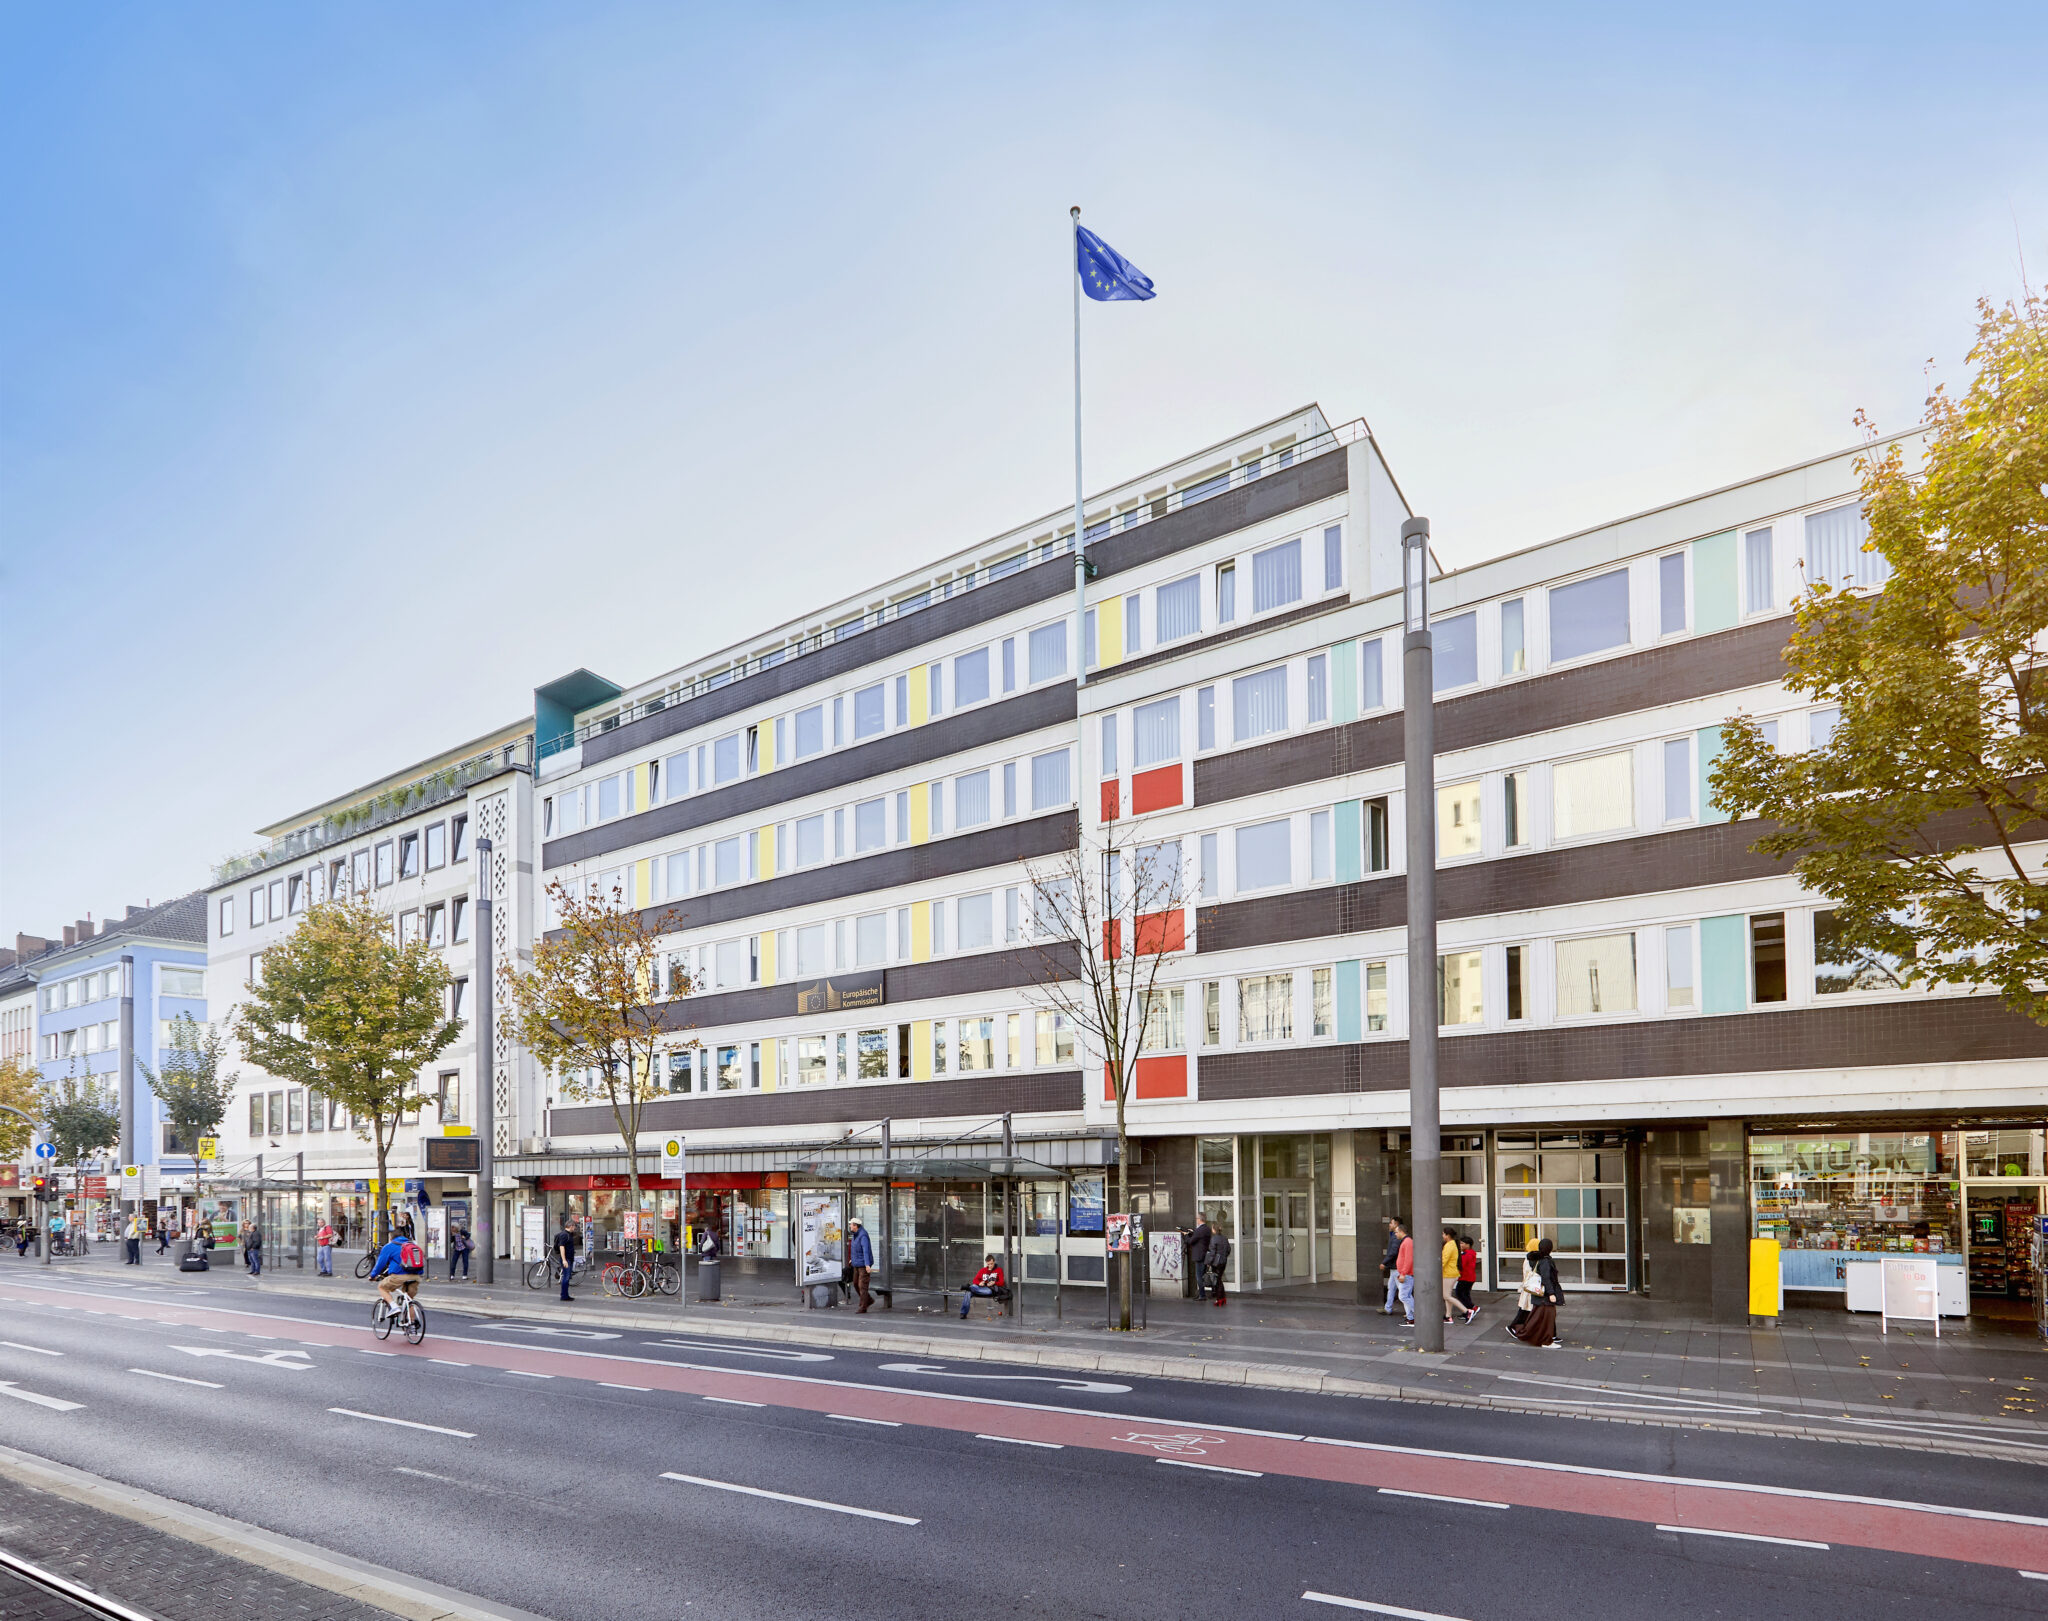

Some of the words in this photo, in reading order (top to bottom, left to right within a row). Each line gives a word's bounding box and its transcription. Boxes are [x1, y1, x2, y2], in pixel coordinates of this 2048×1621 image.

[842, 988, 878, 999] Europäische
[842, 997, 878, 1008] Kommission
[1786, 1141, 1911, 1171] KIOSK
